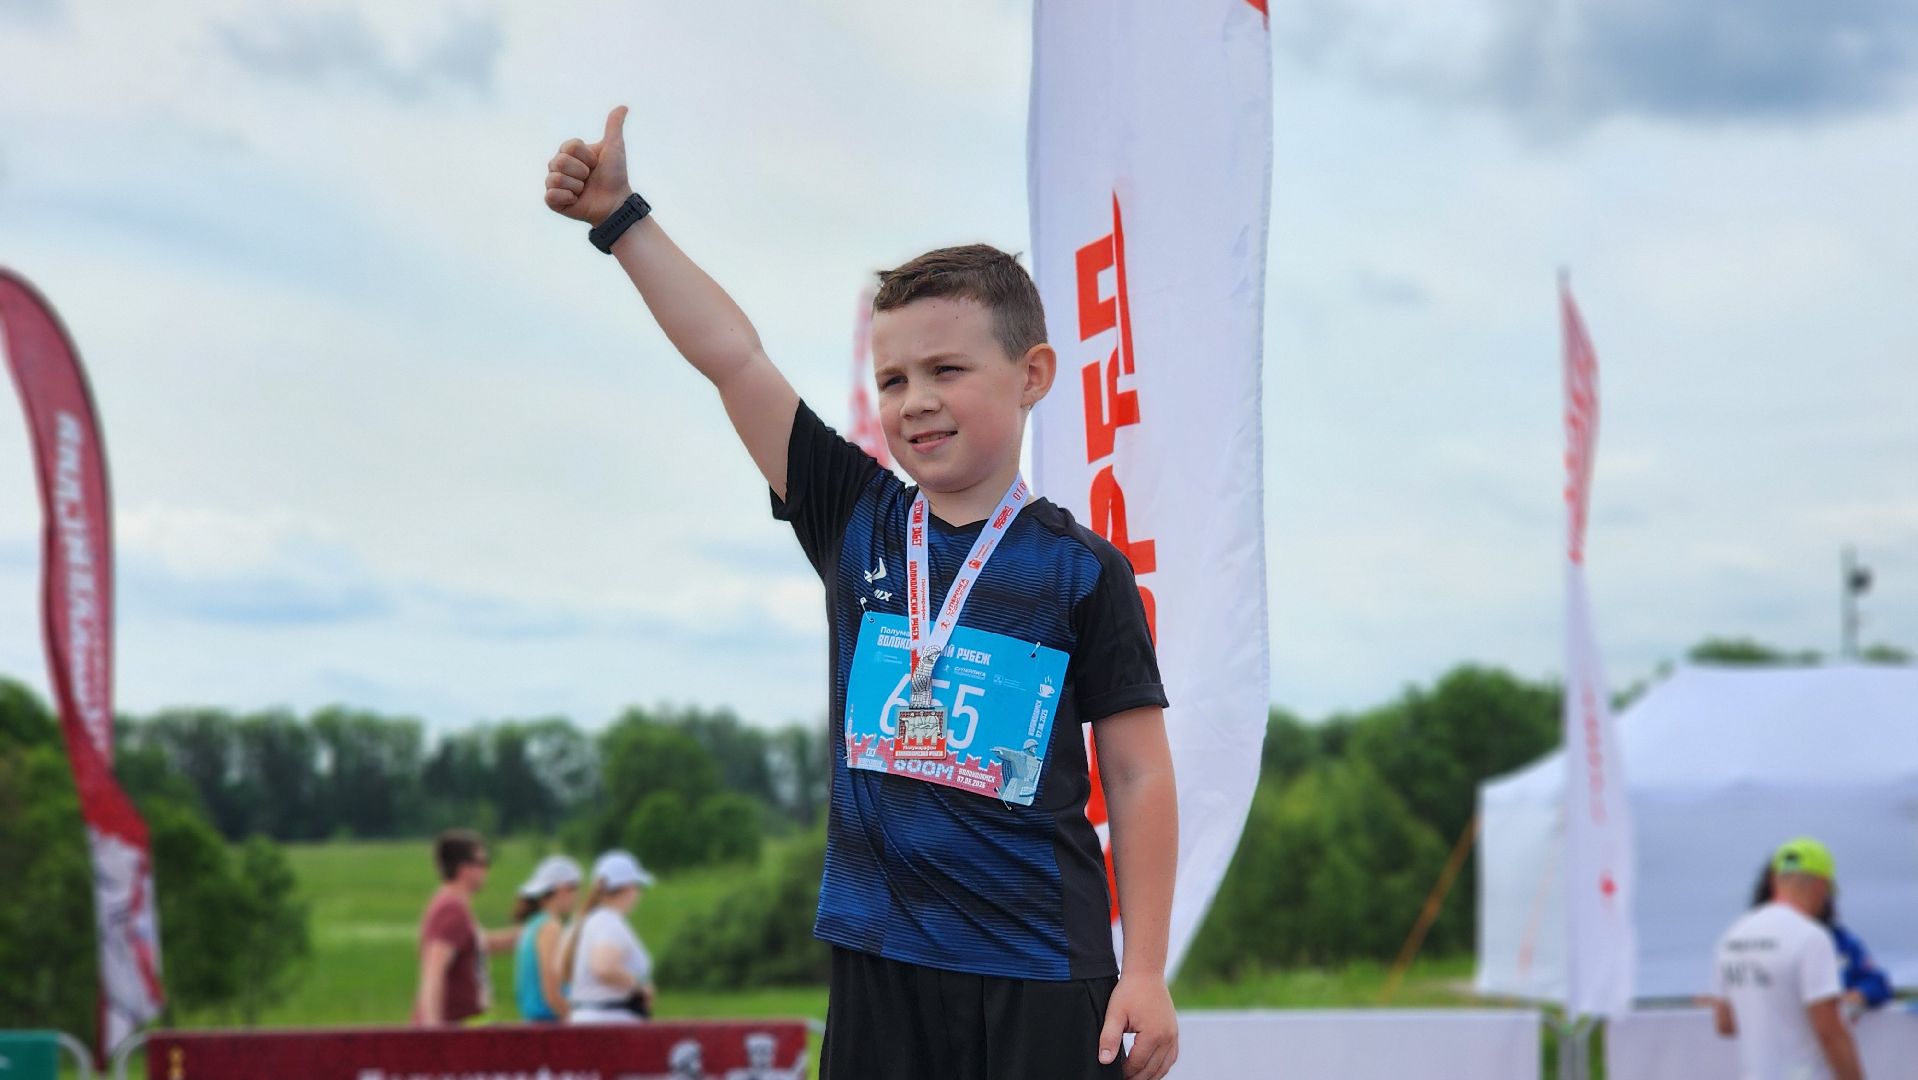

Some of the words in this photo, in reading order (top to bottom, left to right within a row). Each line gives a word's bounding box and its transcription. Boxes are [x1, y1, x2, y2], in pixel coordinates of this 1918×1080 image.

[880, 626, 911, 637] Полума
[956, 647, 992, 666] РУБЕЖ
[879, 673, 985, 750] 65
